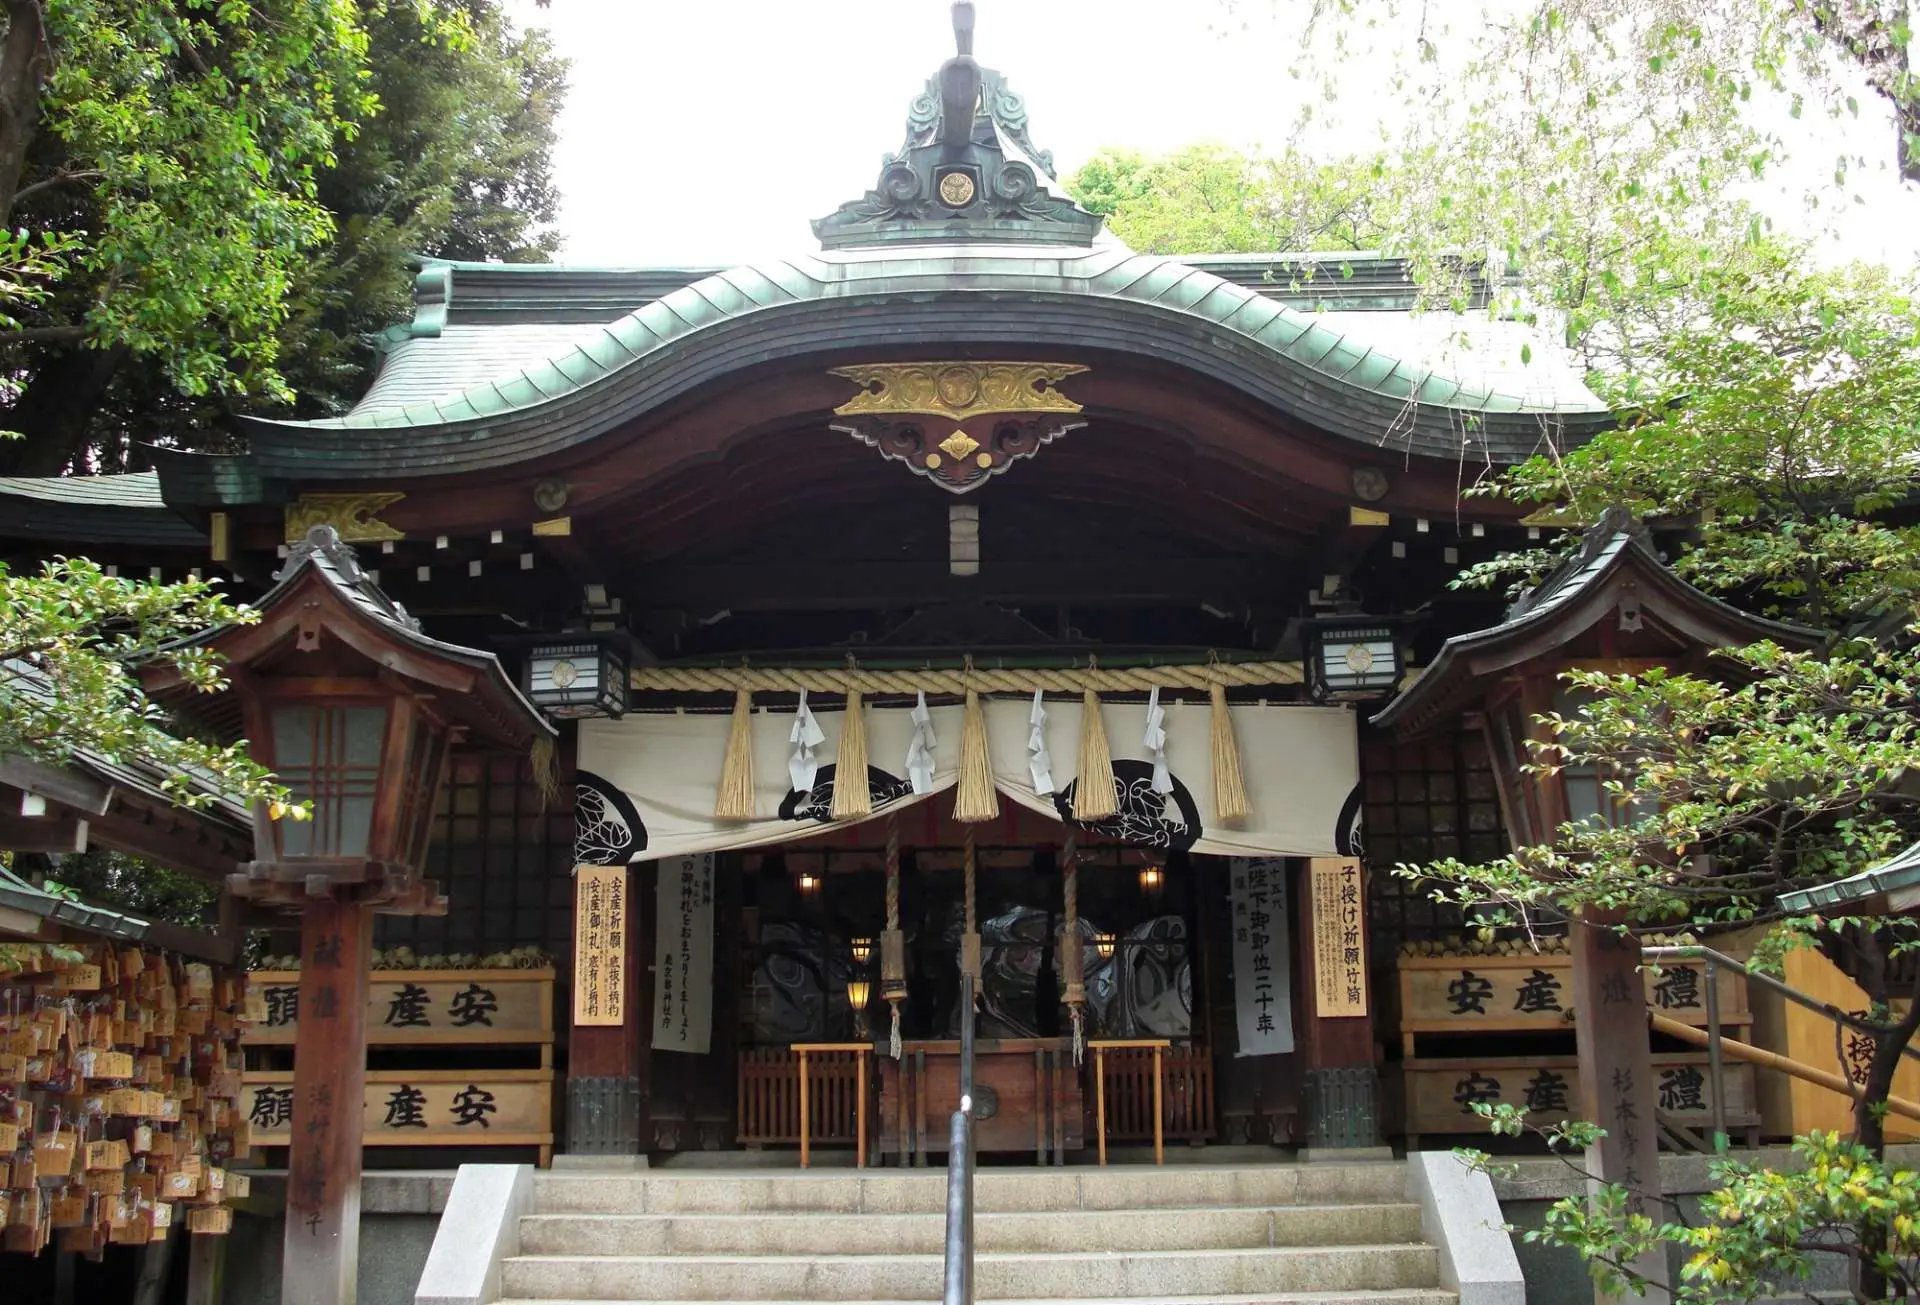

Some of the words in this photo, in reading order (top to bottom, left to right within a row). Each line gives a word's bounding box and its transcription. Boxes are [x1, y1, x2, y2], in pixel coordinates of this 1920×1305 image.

[609, 876, 623, 949] 安産祈願
[1340, 865, 1361, 1005] 子授け祈願竹筒
[679, 854, 695, 1041] の御神札をおまつりしましょう
[259, 983, 498, 1029] 安産願
[1447, 965, 1702, 1015] 安産禮
[249, 1085, 496, 1129] 安産願
